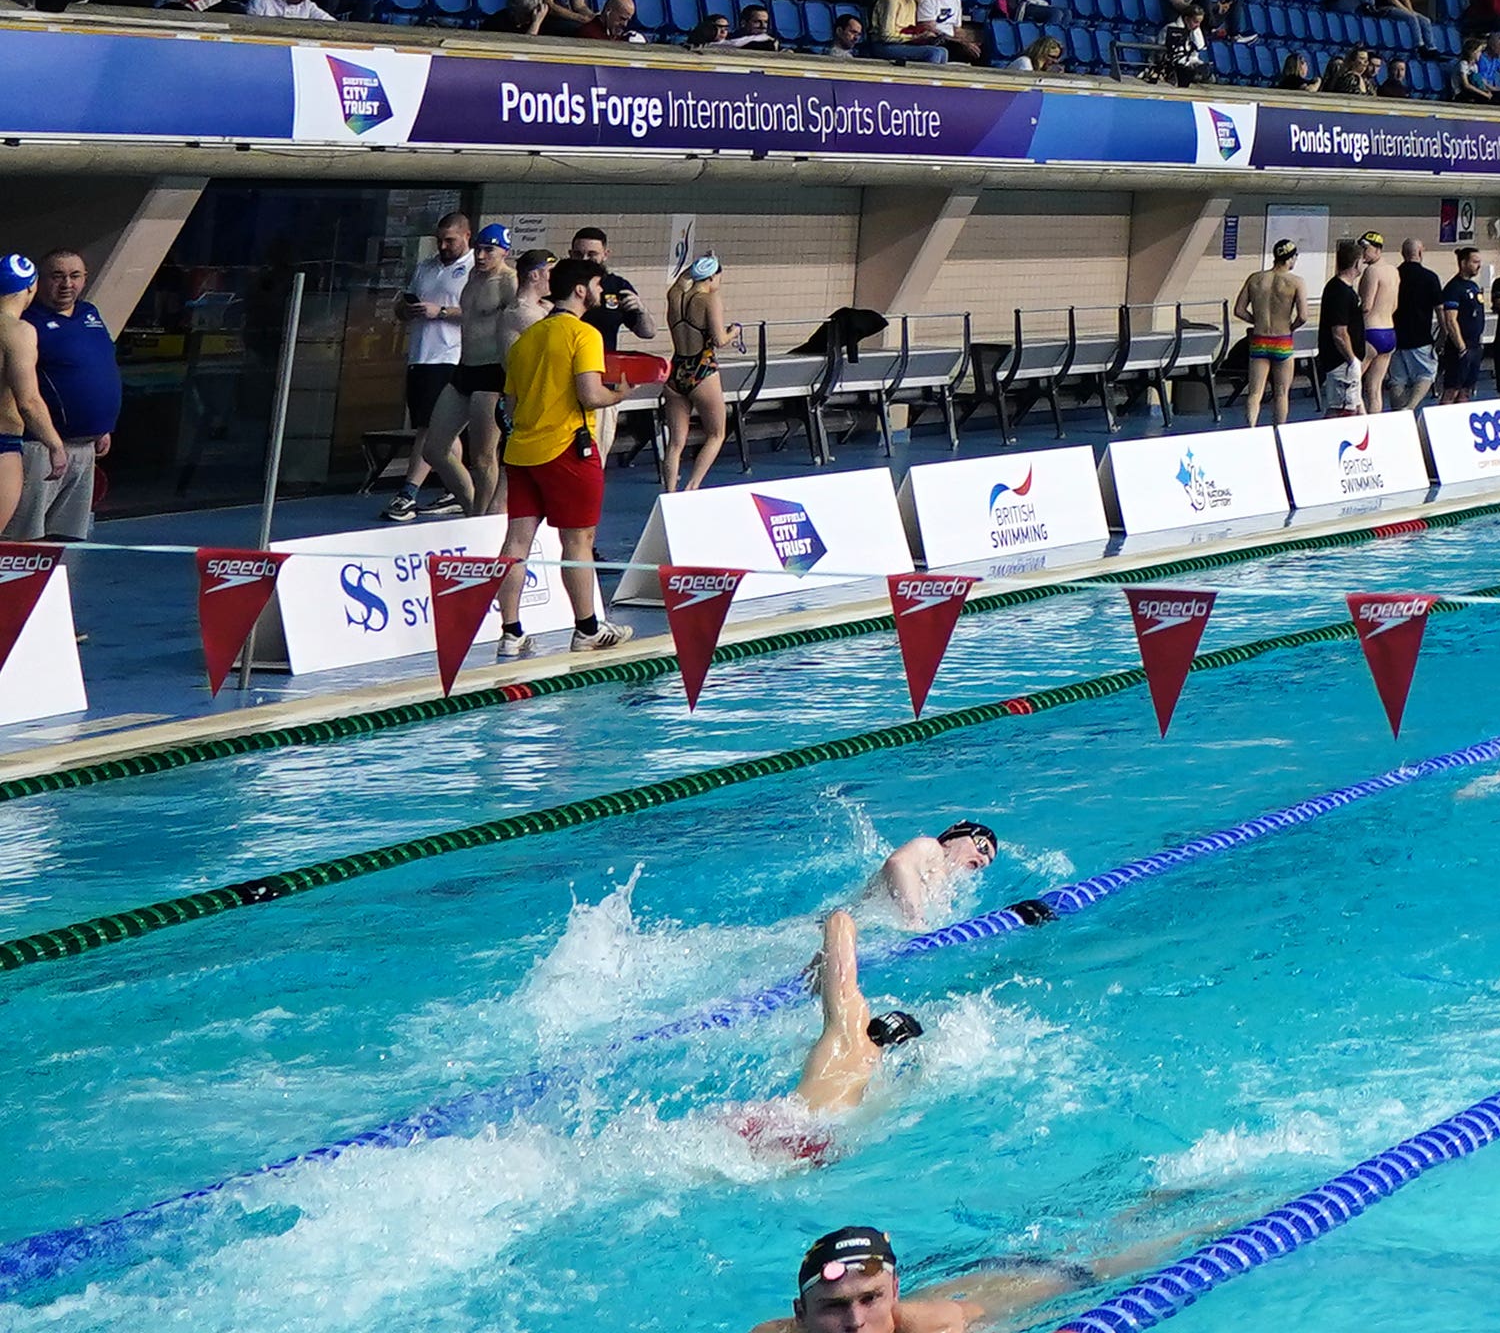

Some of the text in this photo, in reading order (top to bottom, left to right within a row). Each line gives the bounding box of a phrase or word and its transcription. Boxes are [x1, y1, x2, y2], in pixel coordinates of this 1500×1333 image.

[343, 86, 369, 101] CITY
[343, 100, 380, 116] TRUST
[501, 82, 941, 143] Ponds Forge International Sports Centre
[1290, 124, 1331, 153] Ponds
[1333, 126, 1369, 162] Forge
[1371, 128, 1441, 159] International
[1442, 133, 1478, 166] Sports
[1343, 456, 1374, 476] BRITISH
[1340, 473, 1384, 494] SWIMMING
[994, 503, 1036, 526] BRITISH
[772, 524, 798, 542] CITY
[990, 523, 1049, 549] SWIMMING
[776, 537, 812, 558] TRUST
[0, 553, 53, 571] eedo
[207, 558, 277, 577] speedo
[436, 558, 506, 578] speedo
[897, 577, 966, 598] speedo
[1138, 597, 1207, 618] speedo
[1359, 598, 1427, 621] speedo
[835, 1237, 871, 1250] arena
